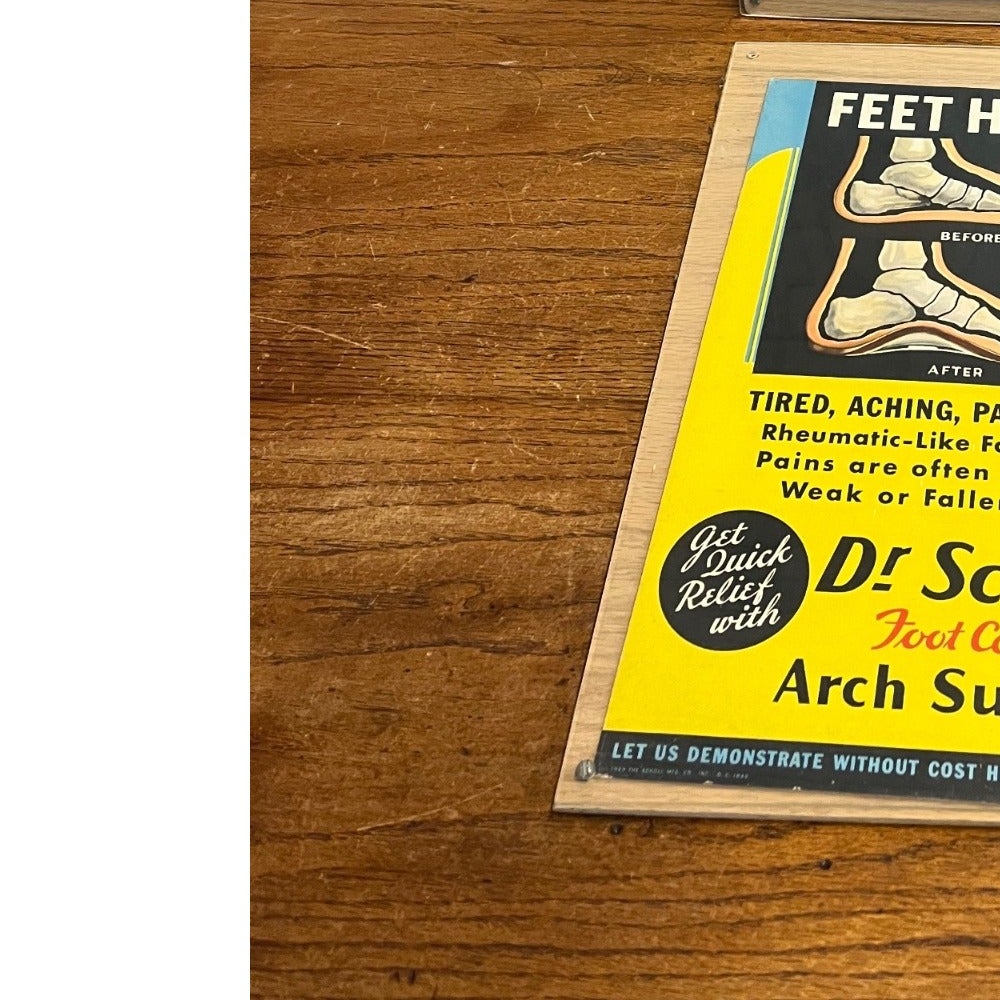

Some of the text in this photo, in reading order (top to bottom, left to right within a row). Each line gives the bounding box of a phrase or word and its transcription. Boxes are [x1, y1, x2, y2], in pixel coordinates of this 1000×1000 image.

[827, 92, 954, 132] FEET
[928, 365, 983, 377] AFTER
[749, 391, 836, 419] TIRED,
[847, 396, 960, 425] ACHING,
[761, 424, 970, 451] Rheumatic-Like
[756, 452, 834, 472] Pains
[850, 460, 898, 475] are
[912, 459, 989, 480] often
[781, 481, 862, 503] Weak
[878, 491, 910, 505] or
[681, 522, 748, 573] Get
[701, 535, 793, 577] Quick
[675, 568, 776, 612] Relief
[710, 593, 781, 634] with
[872, 608, 965, 651] Foot
[773, 658, 904, 710] Arch
[612, 742, 646, 760] LET
[654, 744, 679, 762] US
[687, 747, 824, 770] DEMONSTRATE
[833, 754, 919, 775] WITHOUT
[927, 760, 977, 779] COST
